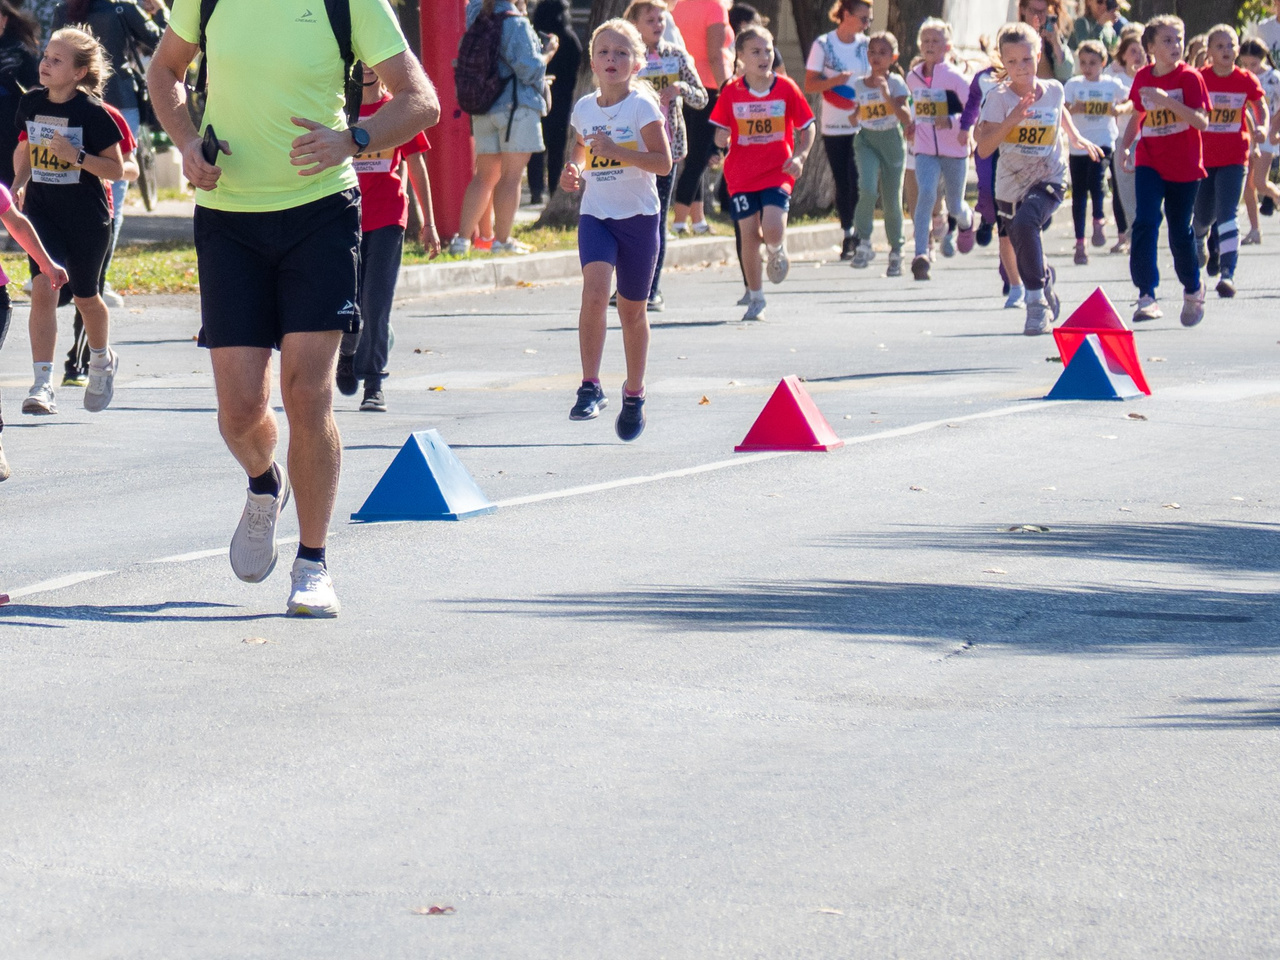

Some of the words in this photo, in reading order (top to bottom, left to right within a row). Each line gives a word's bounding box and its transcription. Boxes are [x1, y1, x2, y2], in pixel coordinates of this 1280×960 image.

[866, 104, 887, 119] 343
[746, 119, 772, 135] 768
[1018, 127, 1047, 144] 887
[733, 195, 750, 212] 13
